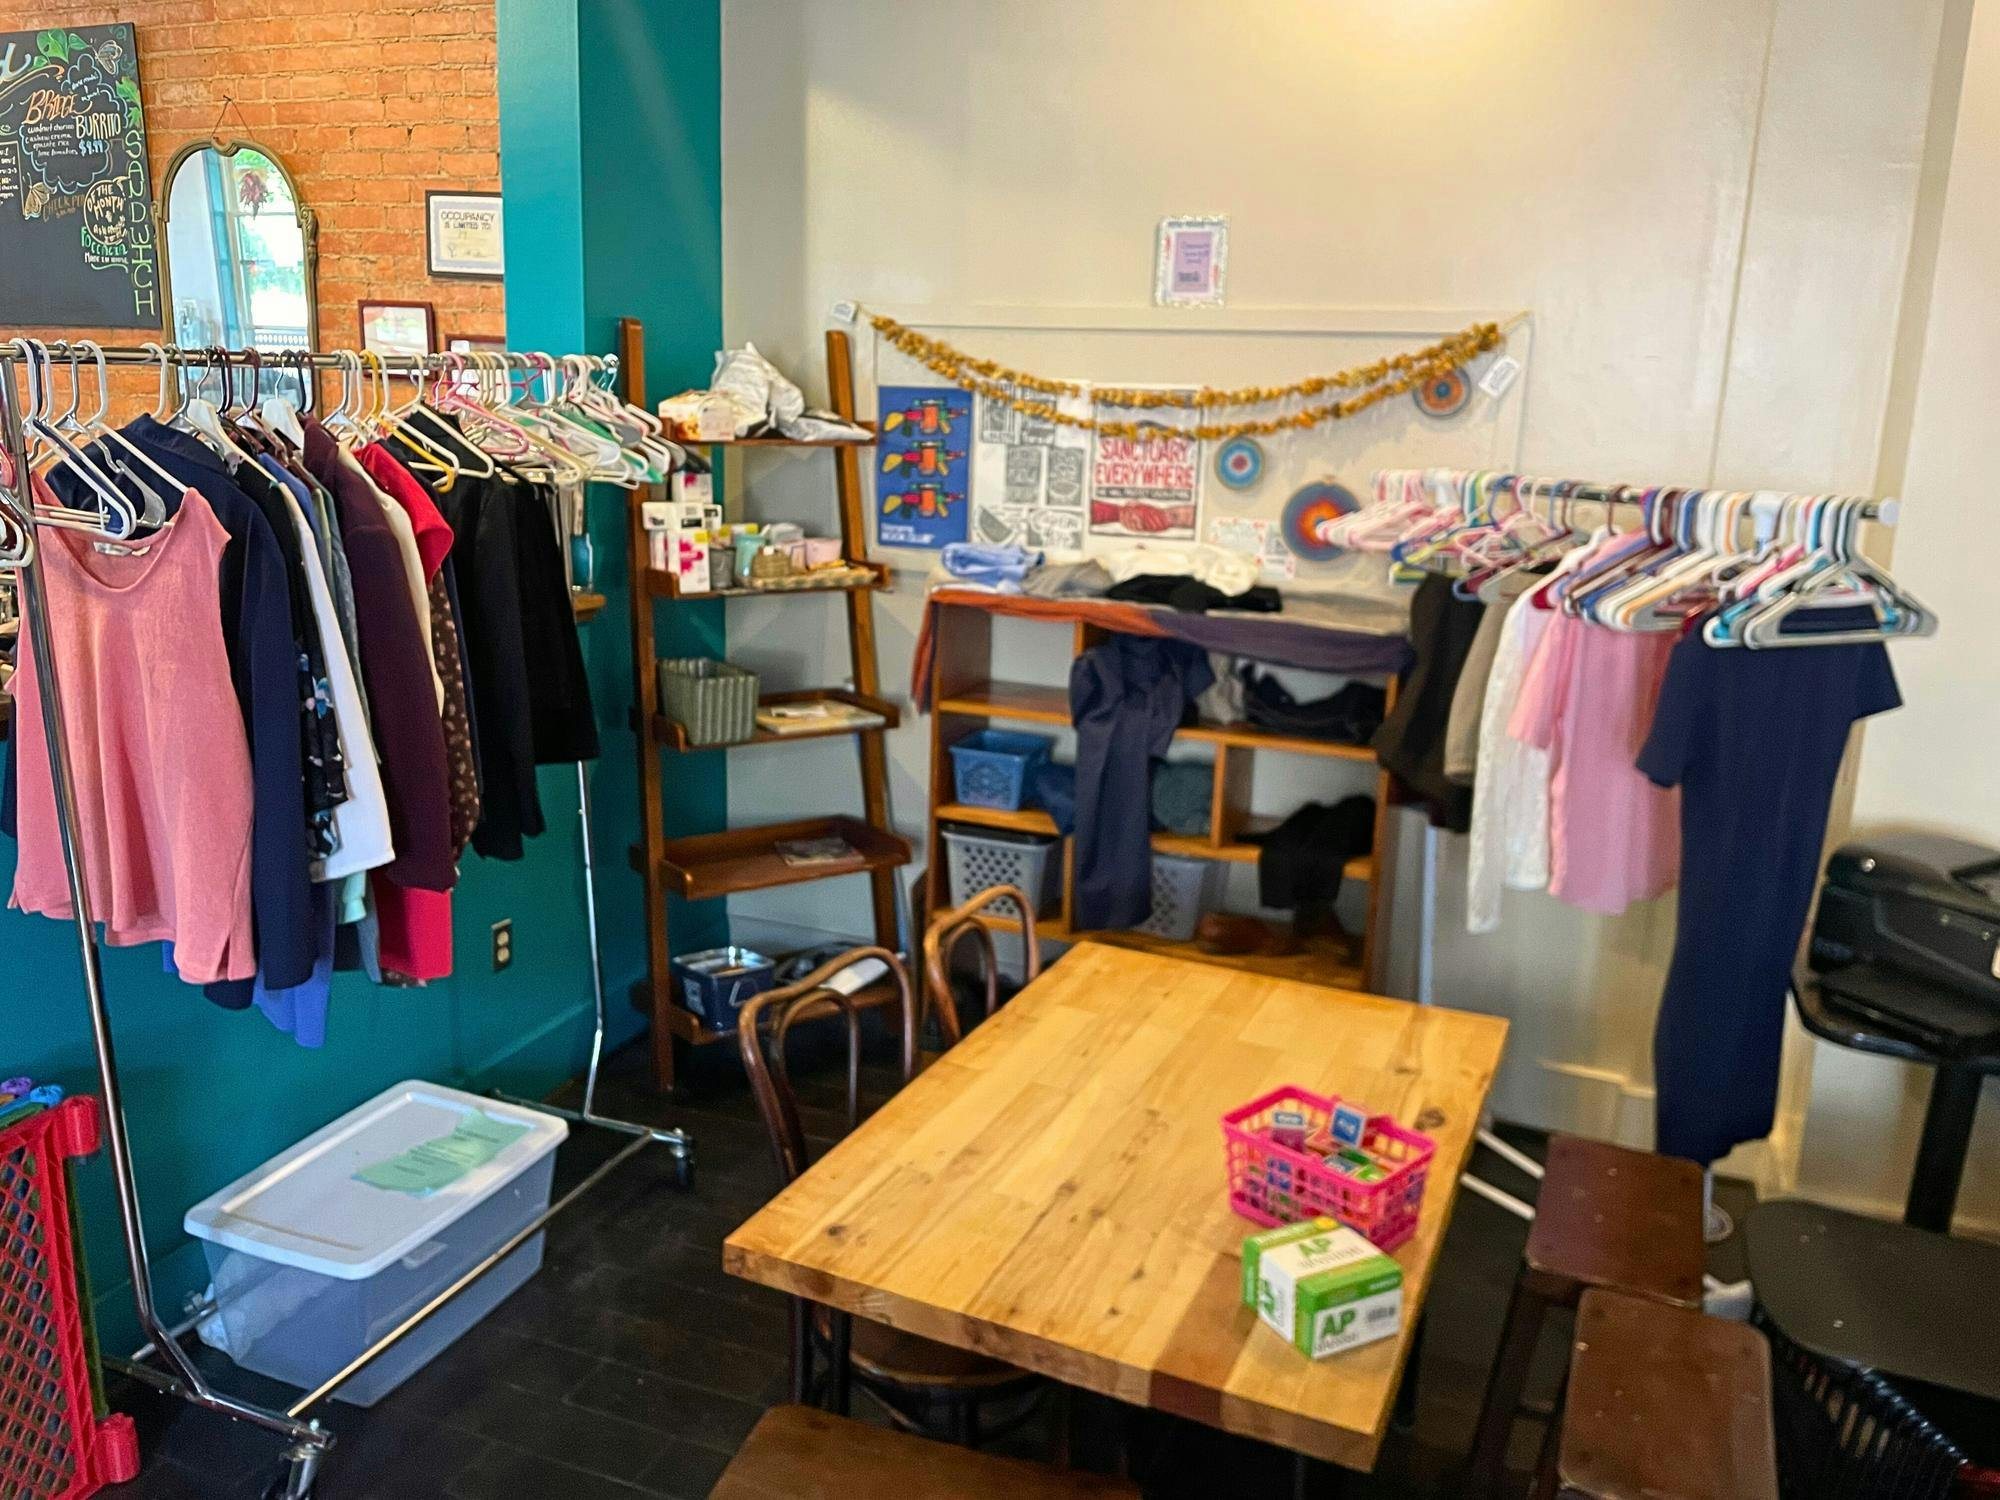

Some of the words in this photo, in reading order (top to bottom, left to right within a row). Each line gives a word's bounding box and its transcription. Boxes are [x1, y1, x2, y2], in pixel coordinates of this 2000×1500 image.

[76, 113, 121, 139] BURRITO
[441, 211, 496, 222] OCCUPANCY
[1100, 436, 1188, 462] SANCTUARY
[1095, 463, 1194, 489] EVERYWHERE
[1321, 1308, 1357, 1340] AP
